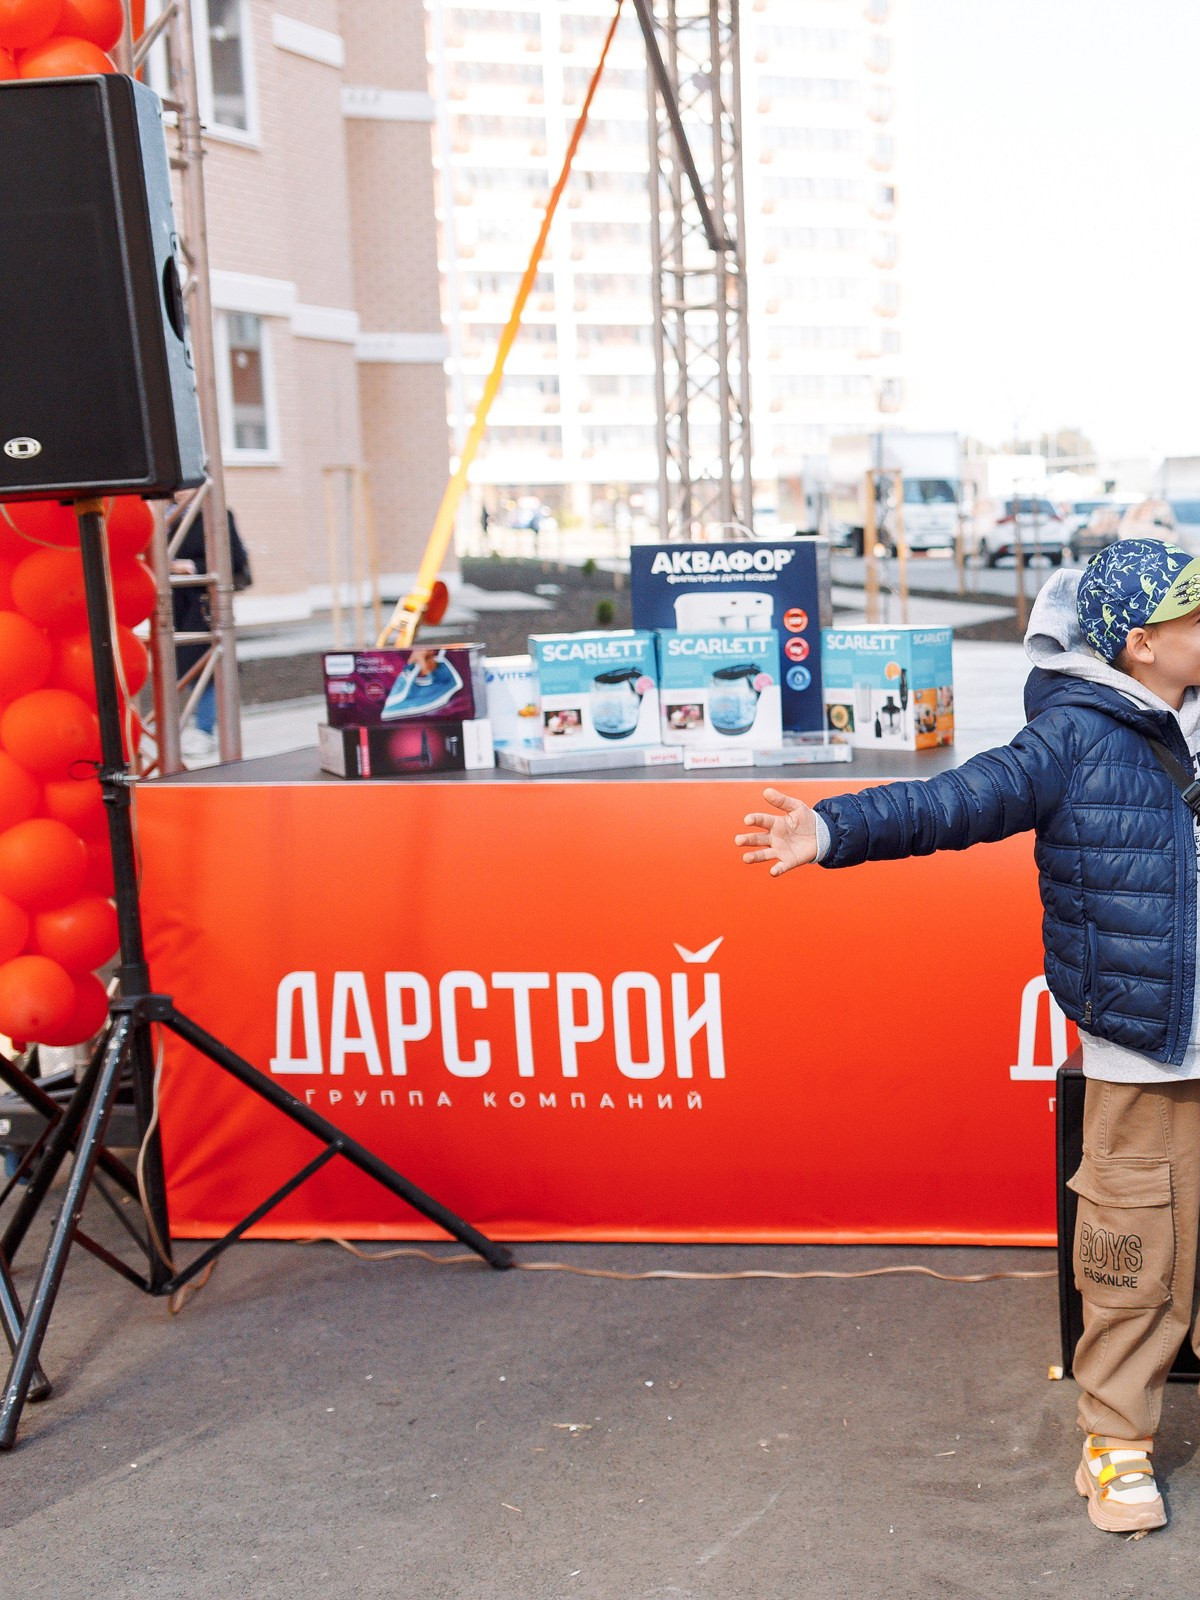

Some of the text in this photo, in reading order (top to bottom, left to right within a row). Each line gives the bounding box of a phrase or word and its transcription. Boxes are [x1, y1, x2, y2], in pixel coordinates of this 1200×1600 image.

[651, 549, 792, 574] АКВАФОР
[542, 641, 644, 662] SCARLETT
[668, 636, 769, 656] SCARLETT
[827, 634, 898, 650] SCARLETT
[269, 936, 727, 1080] ДАРСТРОЙ
[305, 1089, 703, 1110] ГРУППА КОМПАНИЙ
[1079, 1221, 1143, 1273] BOYS
